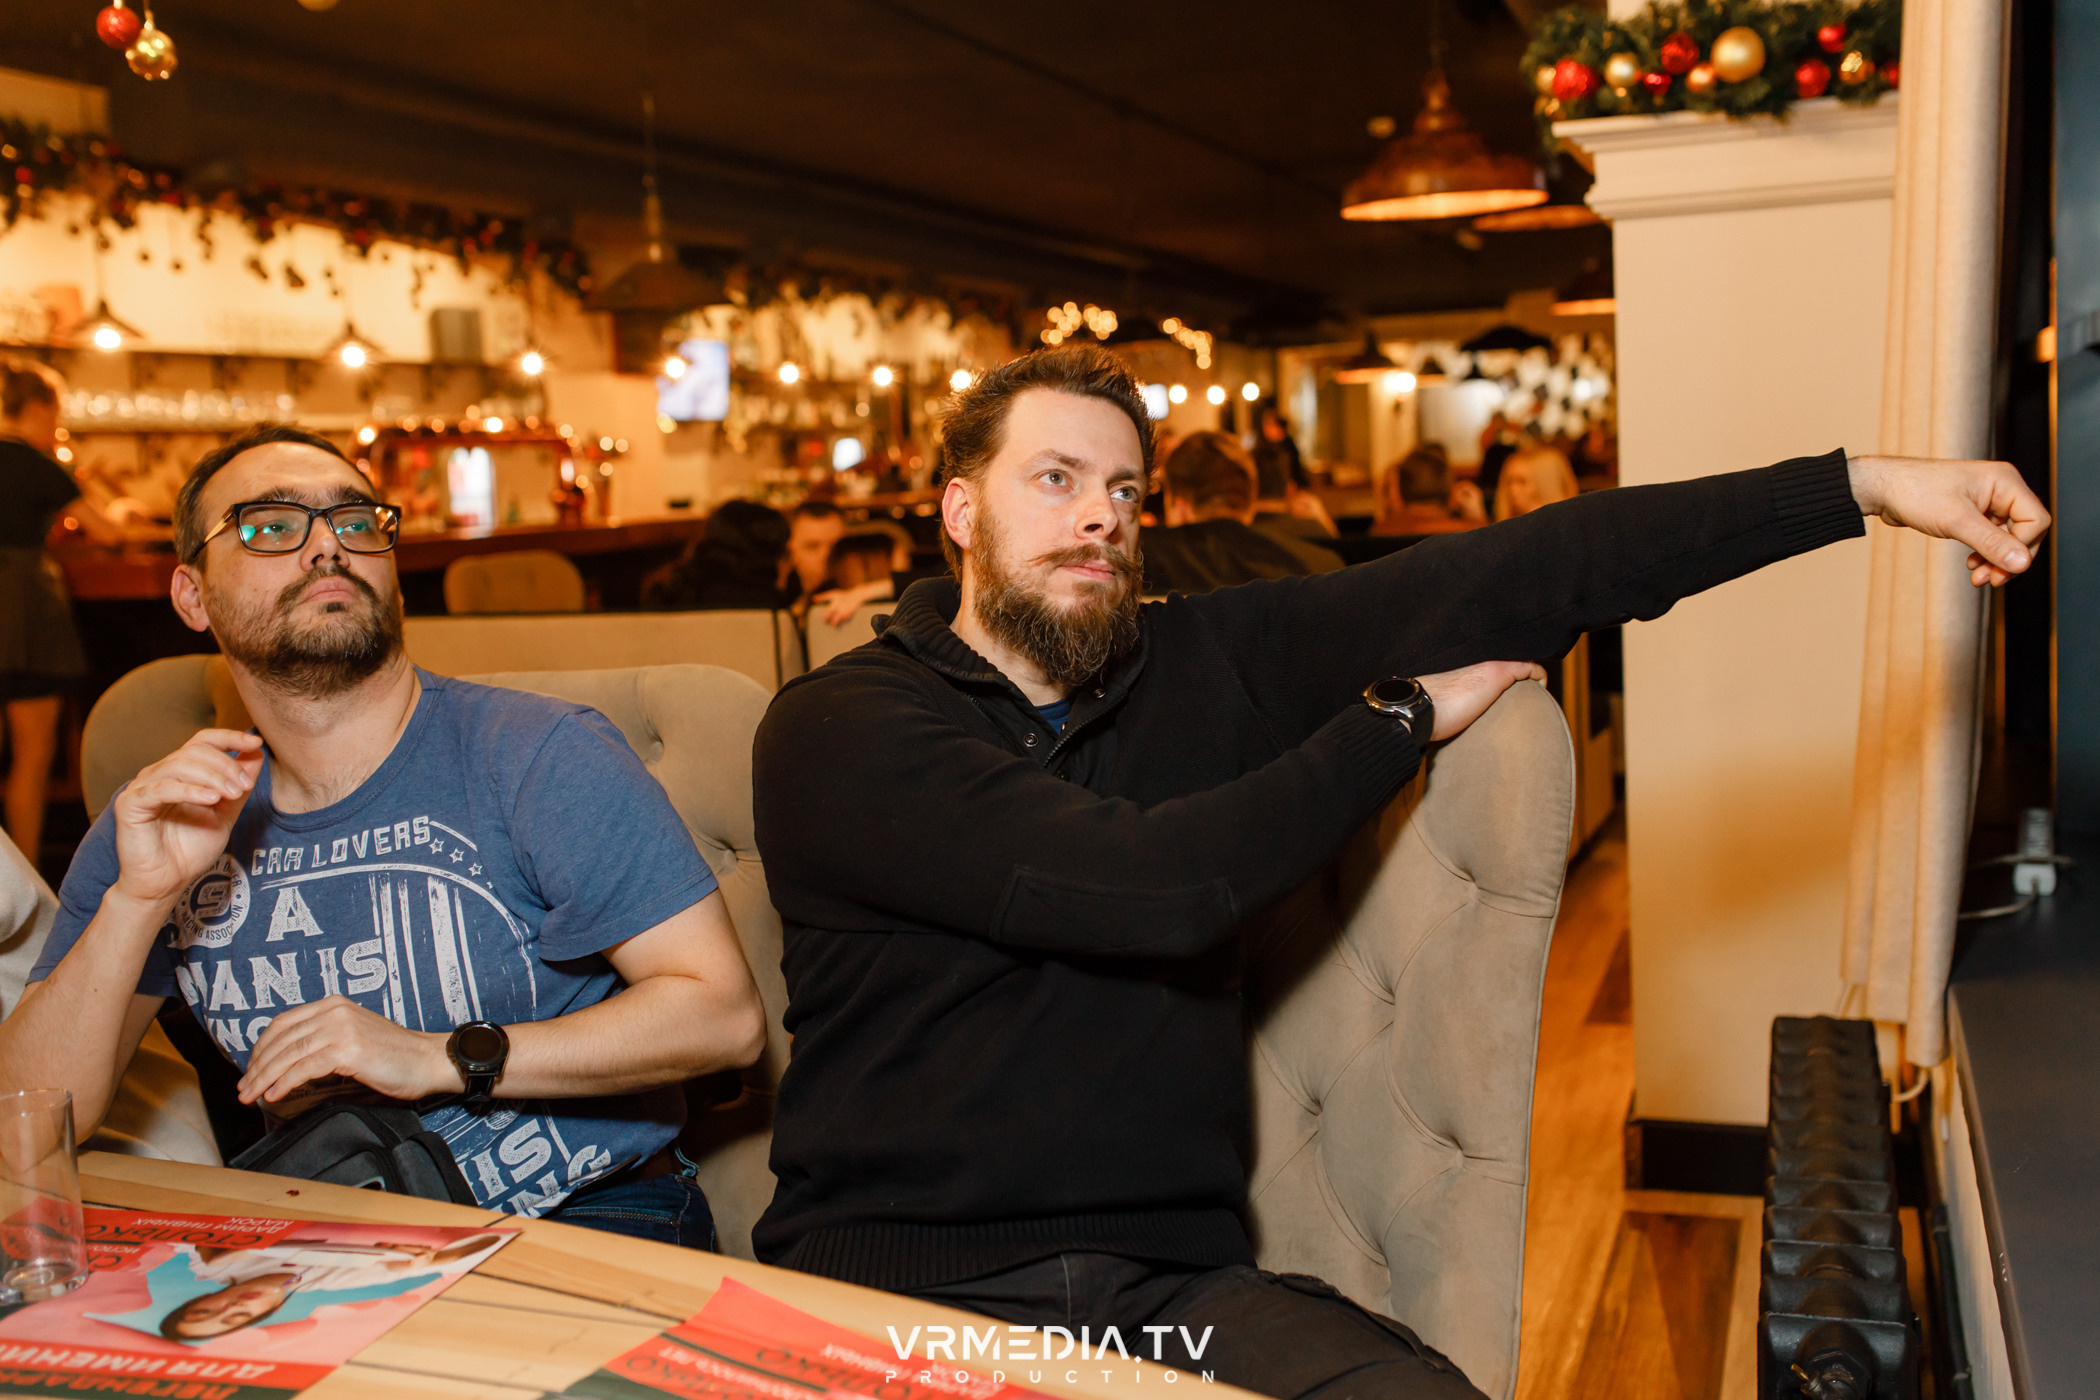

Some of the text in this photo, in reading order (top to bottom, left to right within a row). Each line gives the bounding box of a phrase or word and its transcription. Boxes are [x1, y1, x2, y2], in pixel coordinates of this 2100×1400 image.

[251, 815, 431, 877] CAR LOVERS
[265, 886, 325, 942] A
[315, 937, 388, 999] IS
[131, 1217, 212, 1231] ПИВНЫХ
[224, 1216, 294, 1228] МАРОК
[0, 1344, 276, 1379] ДЛЯ ИМЕНИ
[0, 1370, 240, 1400] ЛЕГЕНДАР
